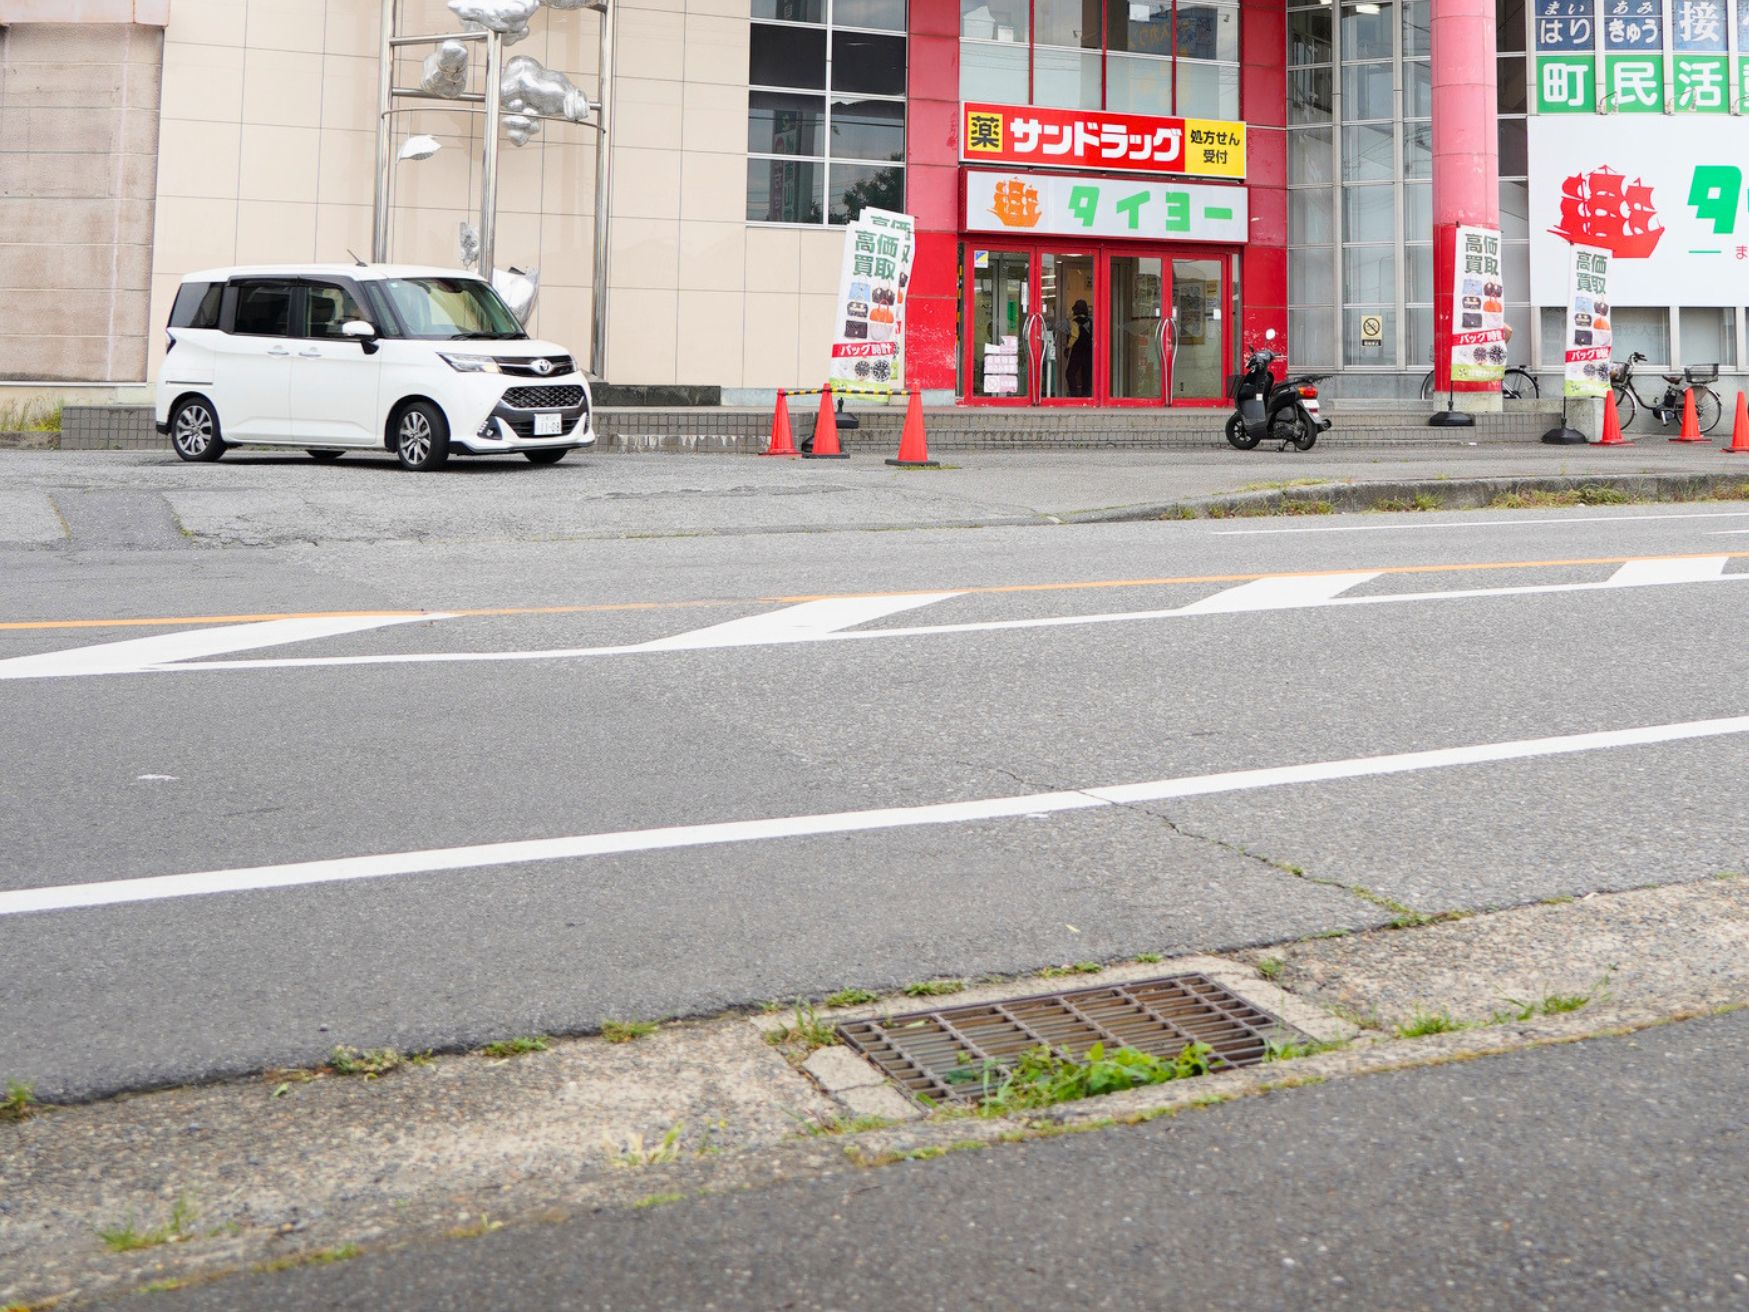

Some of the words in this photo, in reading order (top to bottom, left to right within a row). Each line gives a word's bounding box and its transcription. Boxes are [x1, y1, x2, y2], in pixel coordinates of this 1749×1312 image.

[1543, 61, 1749, 107] 町民活
[970, 115, 1000, 148] 薬
[1009, 116, 1183, 162] サンドラッグ
[1190, 129, 1240, 146] 処方せん
[1203, 149, 1228, 165] 受付
[1067, 185, 1233, 232] タイヨー
[1687, 165, 1749, 234] タ
[855, 229, 899, 258] 高価
[1464, 233, 1499, 256] 高価
[853, 254, 897, 281] 買取
[1464, 255, 1499, 276] 買取
[1576, 251, 1608, 275] 高価
[1576, 272, 1606, 295] 買取
